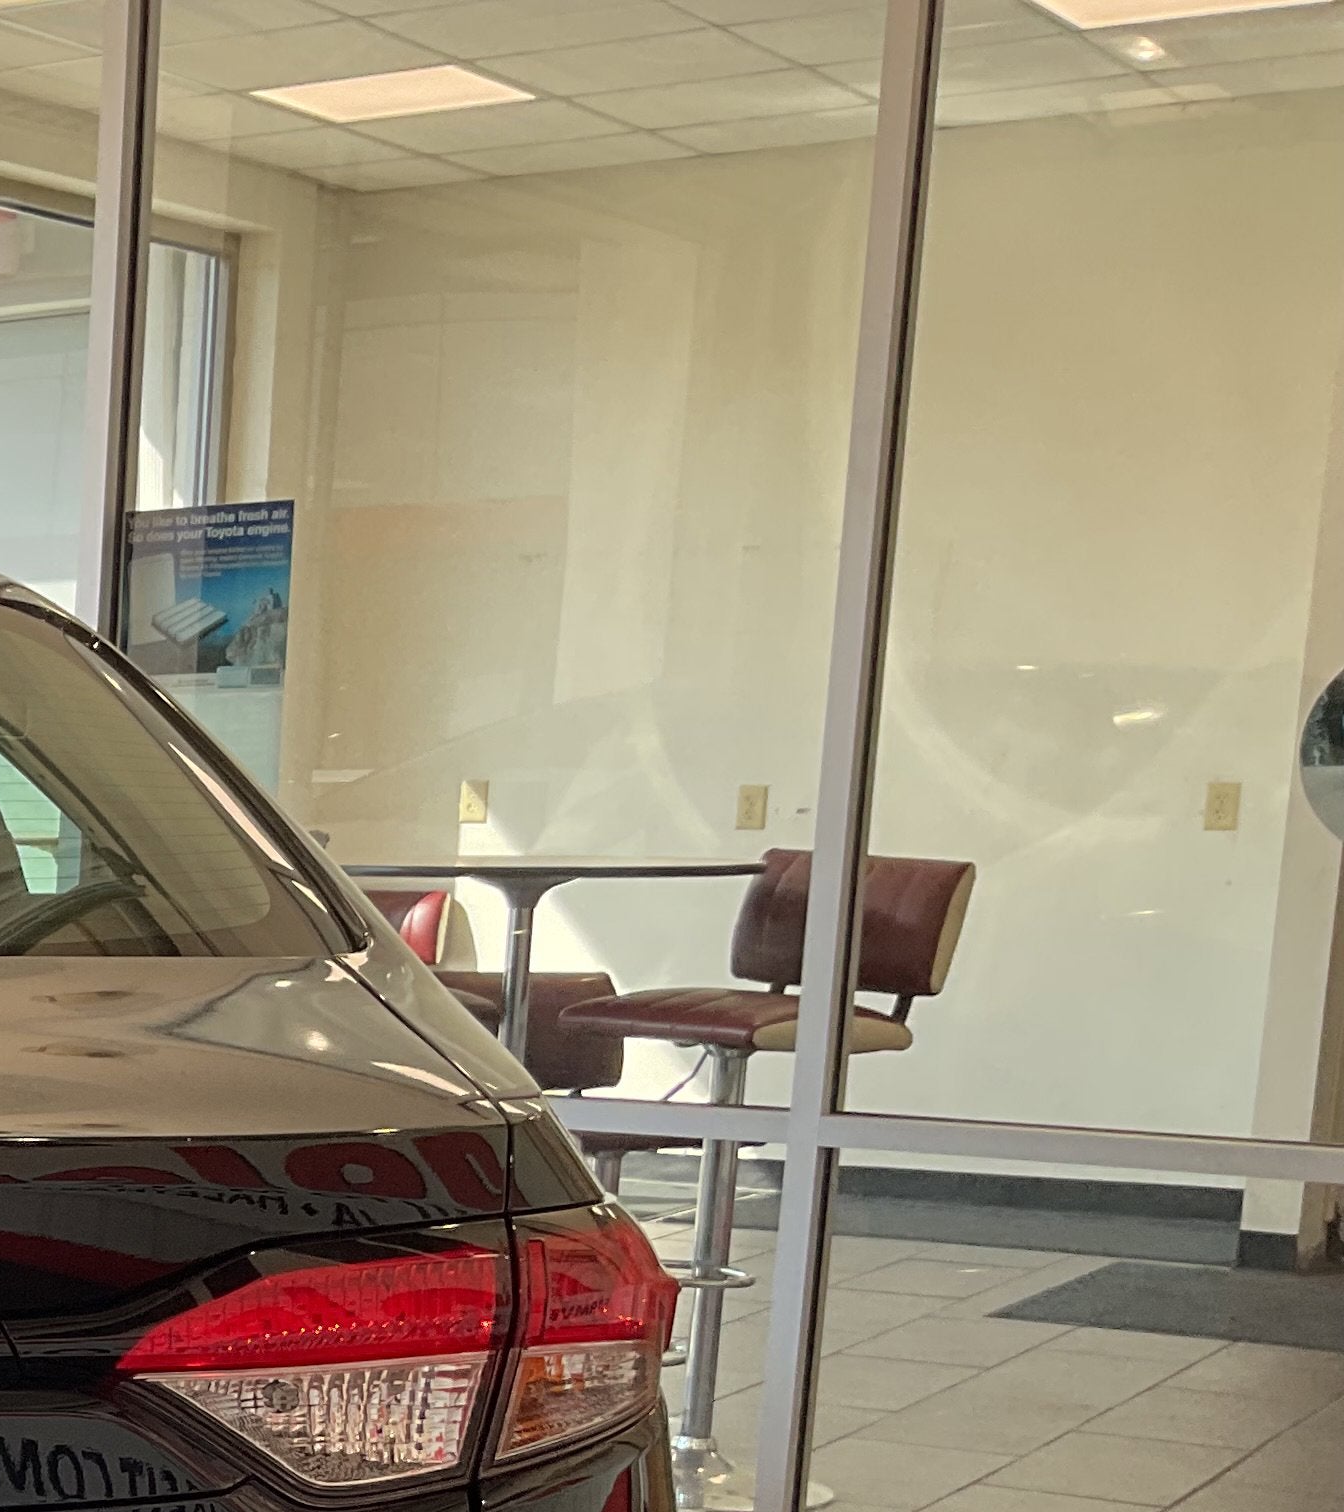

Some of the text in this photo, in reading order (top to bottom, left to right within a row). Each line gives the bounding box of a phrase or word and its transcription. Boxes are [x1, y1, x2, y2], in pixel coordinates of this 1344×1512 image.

[176, 515, 186, 526] to
[190, 512, 235, 525] breathe
[238, 510, 268, 522] fresh
[177, 529, 203, 543] your
[207, 526, 244, 540] Toyota
[247, 523, 289, 537] engine.
